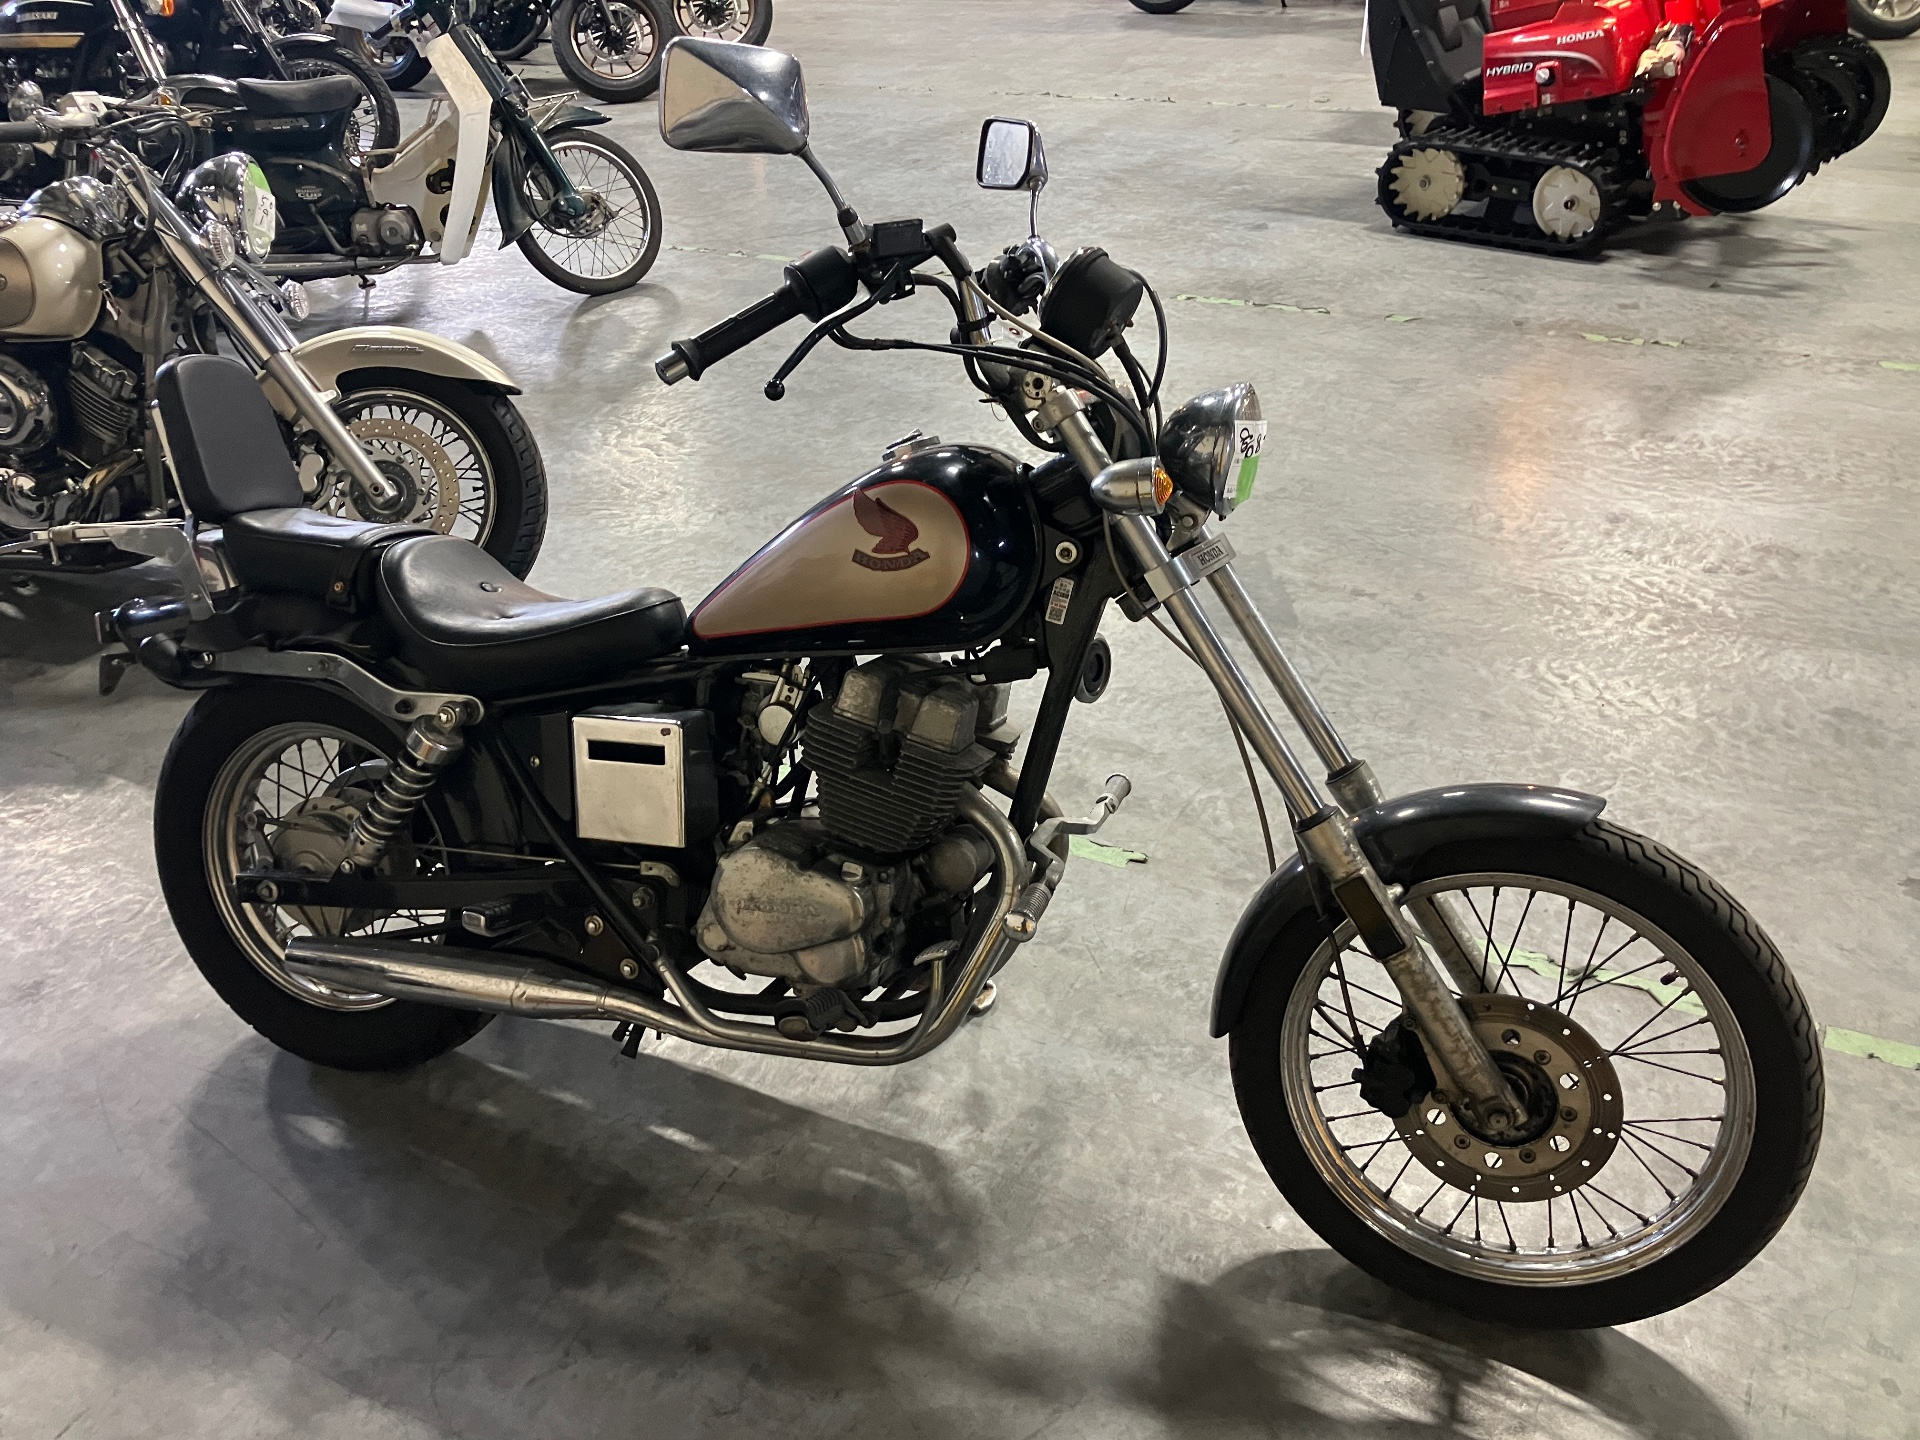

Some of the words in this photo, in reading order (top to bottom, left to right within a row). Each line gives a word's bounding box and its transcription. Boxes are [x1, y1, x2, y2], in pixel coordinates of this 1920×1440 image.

[1556, 29, 1605, 45] HONDA
[1485, 61, 1534, 77] HYBRID
[855, 550, 927, 570] HONDA
[1198, 546, 1223, 565] HONDA
